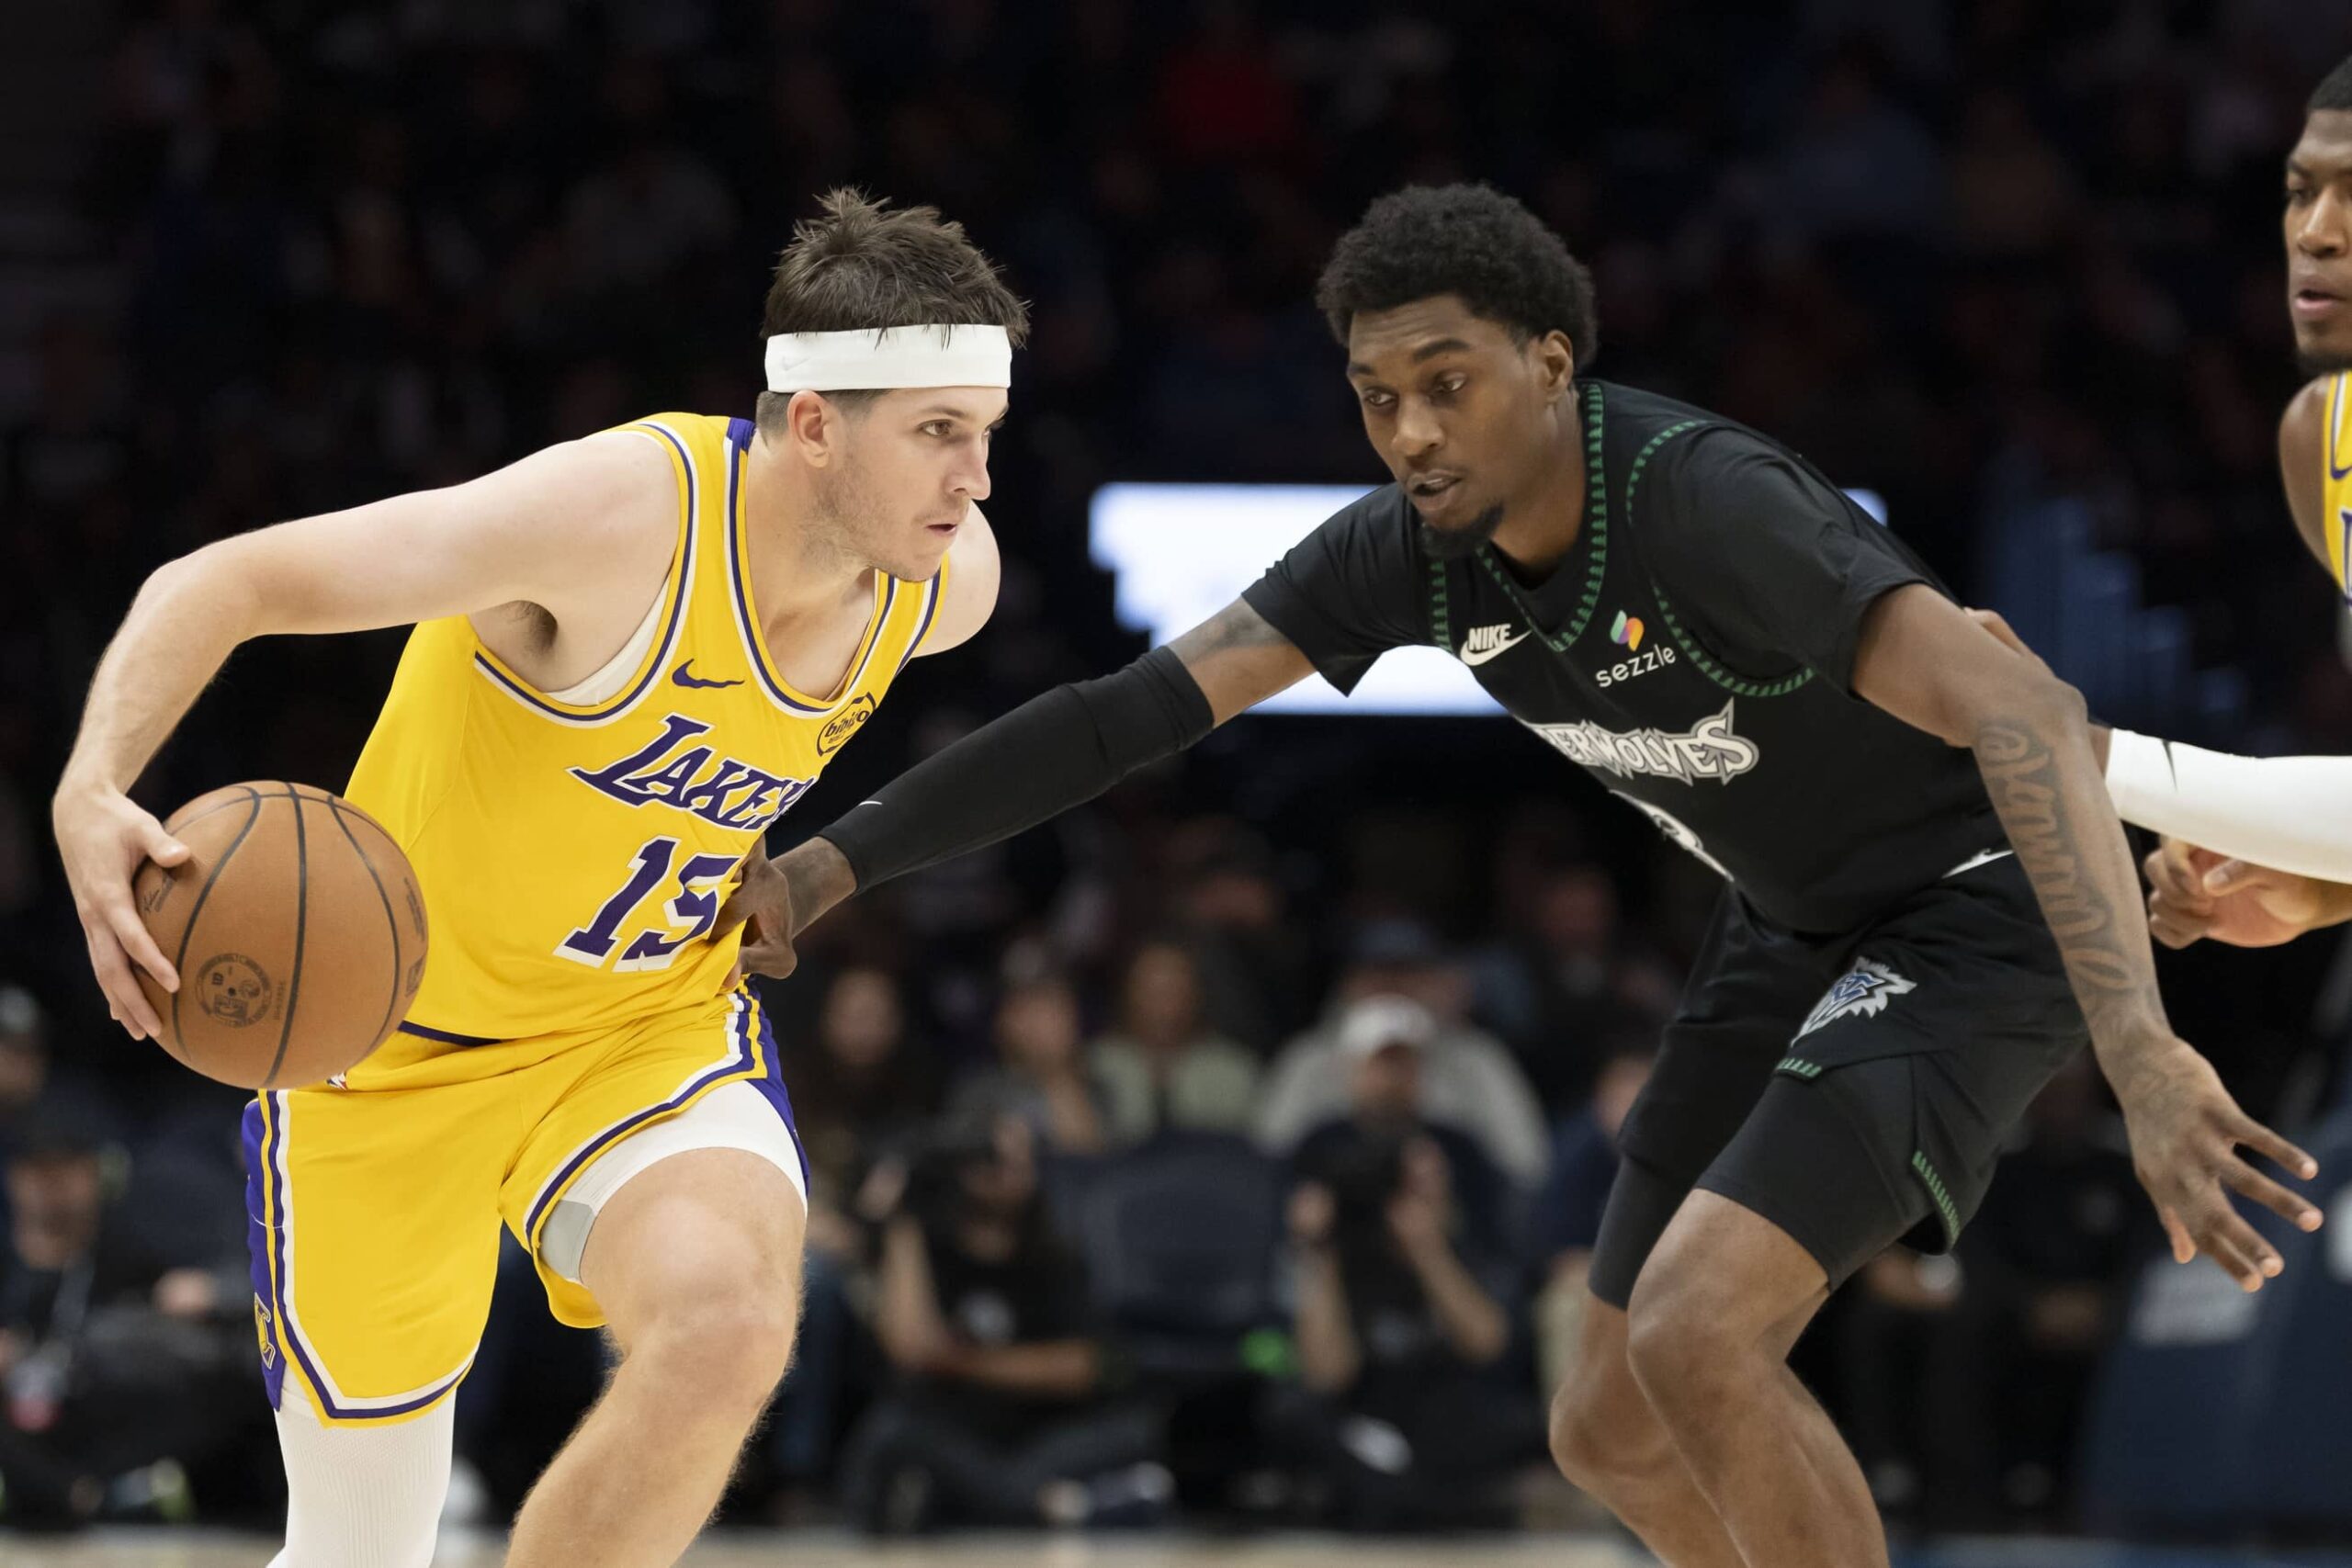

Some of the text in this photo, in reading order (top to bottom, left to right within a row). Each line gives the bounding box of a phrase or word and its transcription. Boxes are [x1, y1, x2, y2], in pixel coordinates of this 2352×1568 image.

[1469, 623, 1511, 650] NIKE
[1595, 644, 1677, 688] sezzle
[1514, 695, 1760, 786] ERWOLVES
[552, 833, 742, 973] 15
